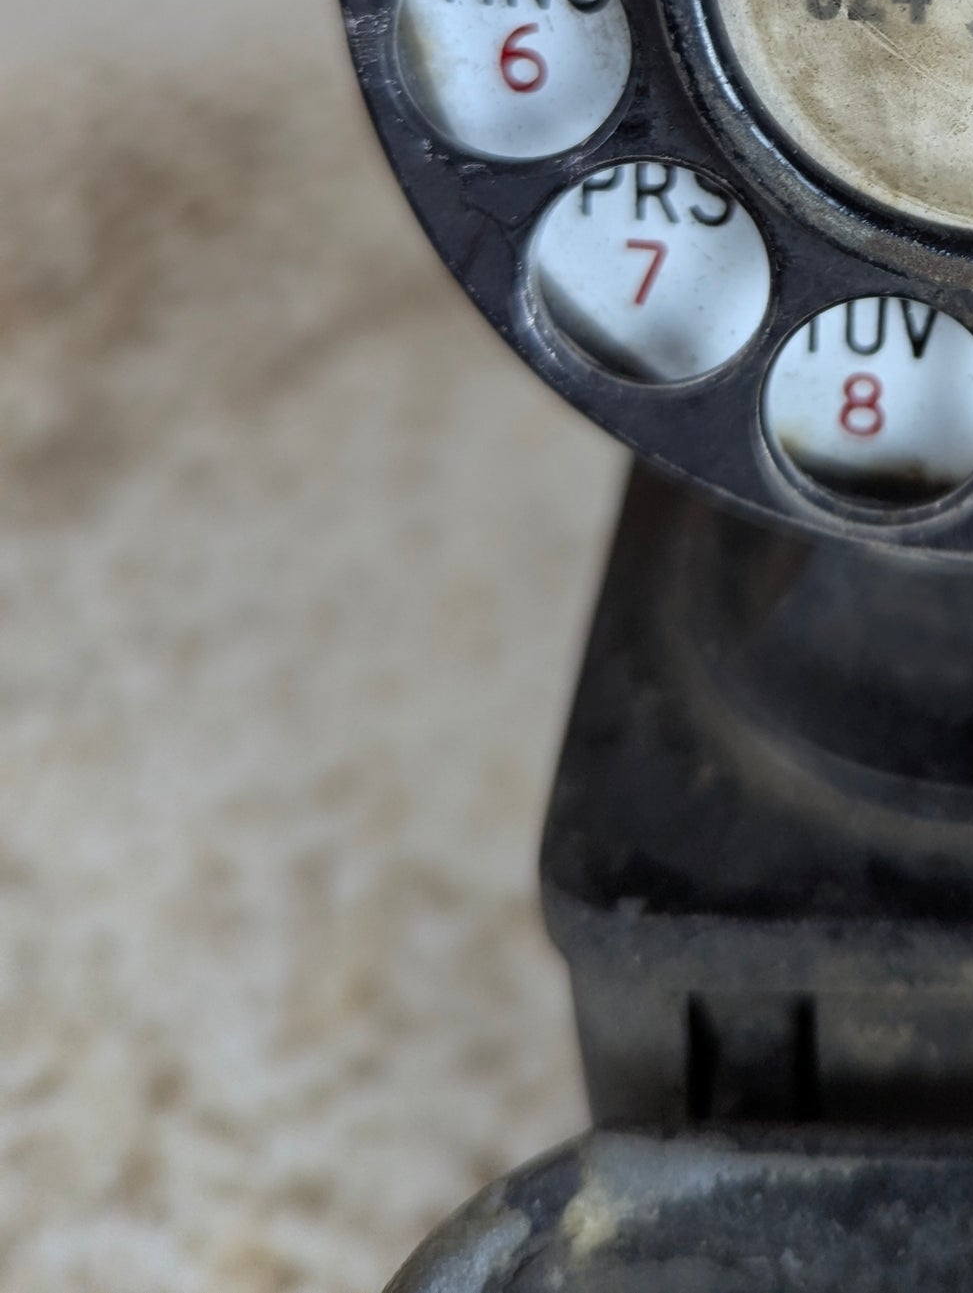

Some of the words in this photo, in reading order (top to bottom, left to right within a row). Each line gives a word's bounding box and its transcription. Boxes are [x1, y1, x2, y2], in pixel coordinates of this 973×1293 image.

[500, 22, 550, 94] 6
[625, 238, 669, 306] 7
[839, 372, 886, 438] 8
